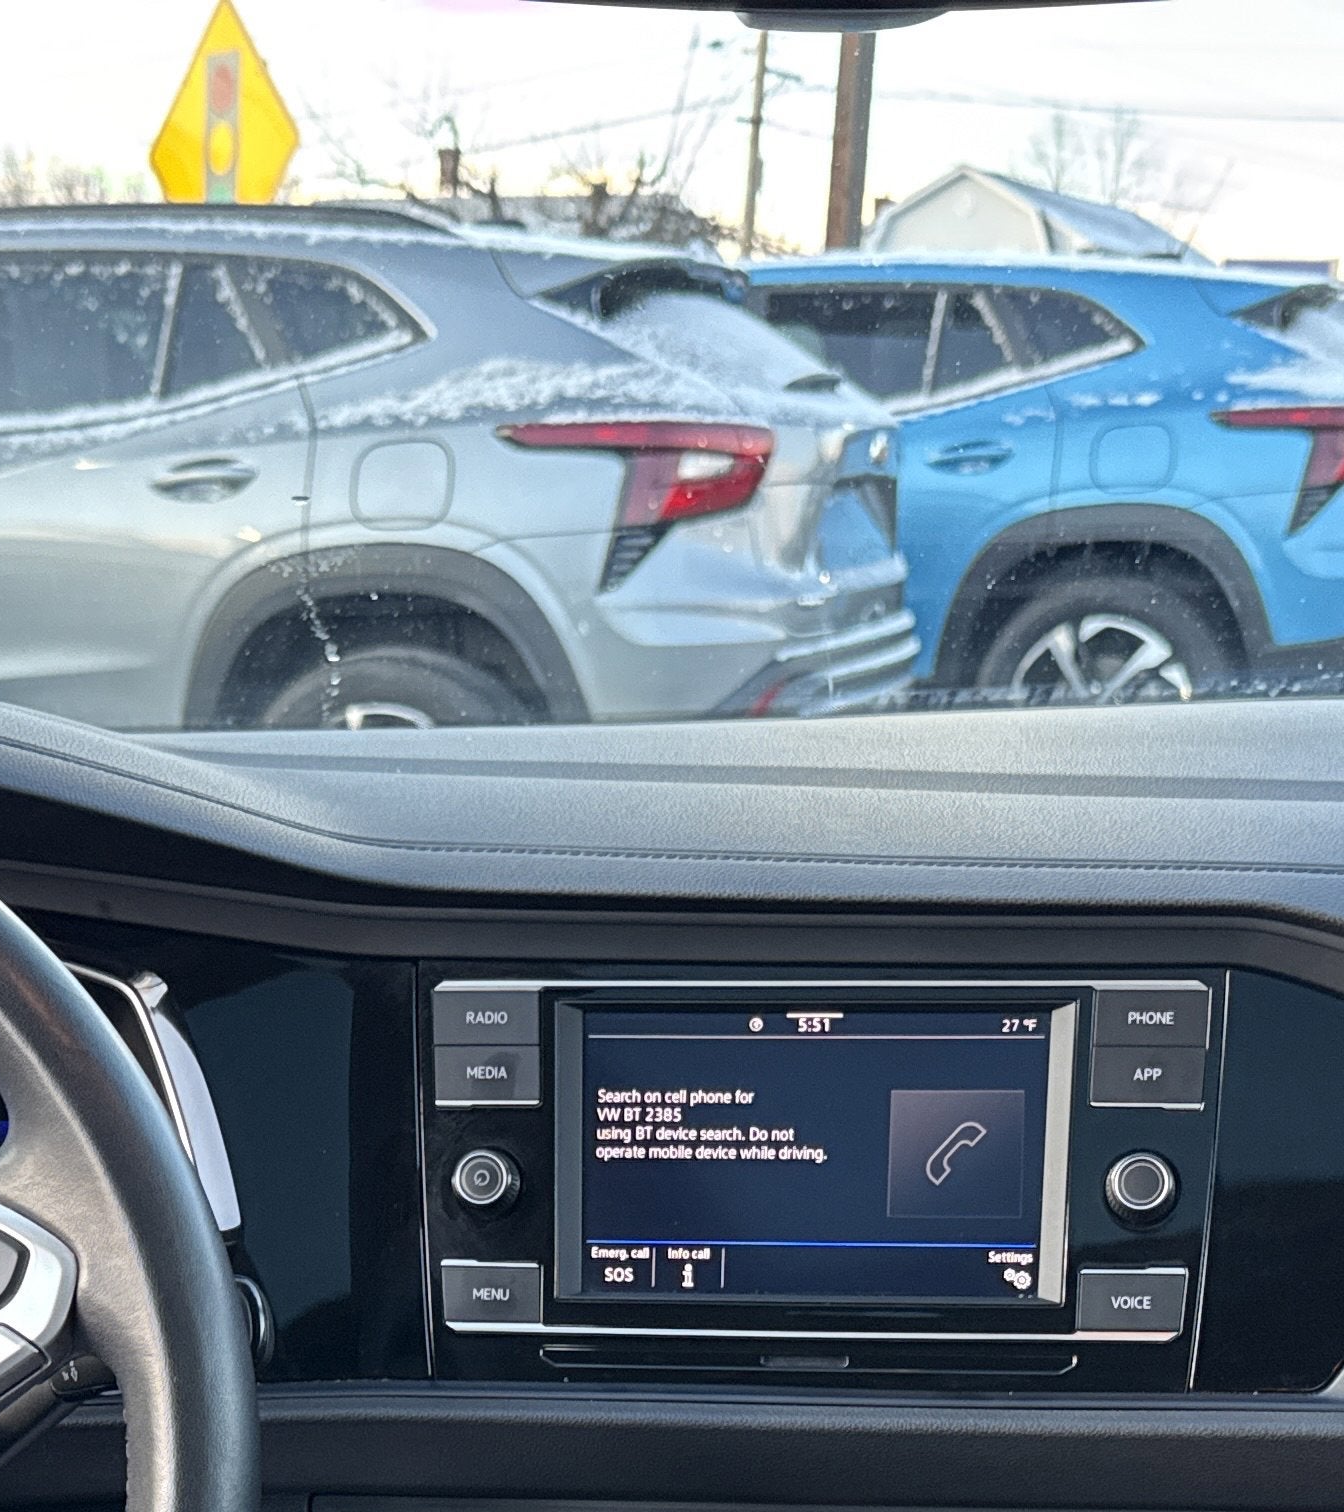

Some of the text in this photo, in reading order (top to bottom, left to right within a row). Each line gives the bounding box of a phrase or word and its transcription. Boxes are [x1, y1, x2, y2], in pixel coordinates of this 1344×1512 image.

[465, 1011, 508, 1025] RADIO
[1127, 1011, 1175, 1026] PHONE
[797, 1018, 830, 1033] 5:51
[1001, 1019, 1019, 1033] 27
[466, 1065, 508, 1079] MEDIA
[1133, 1067, 1162, 1081] APP
[597, 1088, 755, 1107] Search on cell phone for
[596, 1107, 682, 1122] VW BT 2385
[596, 1126, 795, 1143] using BT device search. Do not
[595, 1145, 828, 1163] operate mobile device while driving.
[590, 1246, 650, 1260] Emerg. call
[667, 1247, 711, 1260] Info call
[987, 1251, 1033, 1264] Settings
[604, 1267, 634, 1282] SOS
[472, 1288, 510, 1301] MENU
[1111, 1296, 1151, 1310] VOICE
